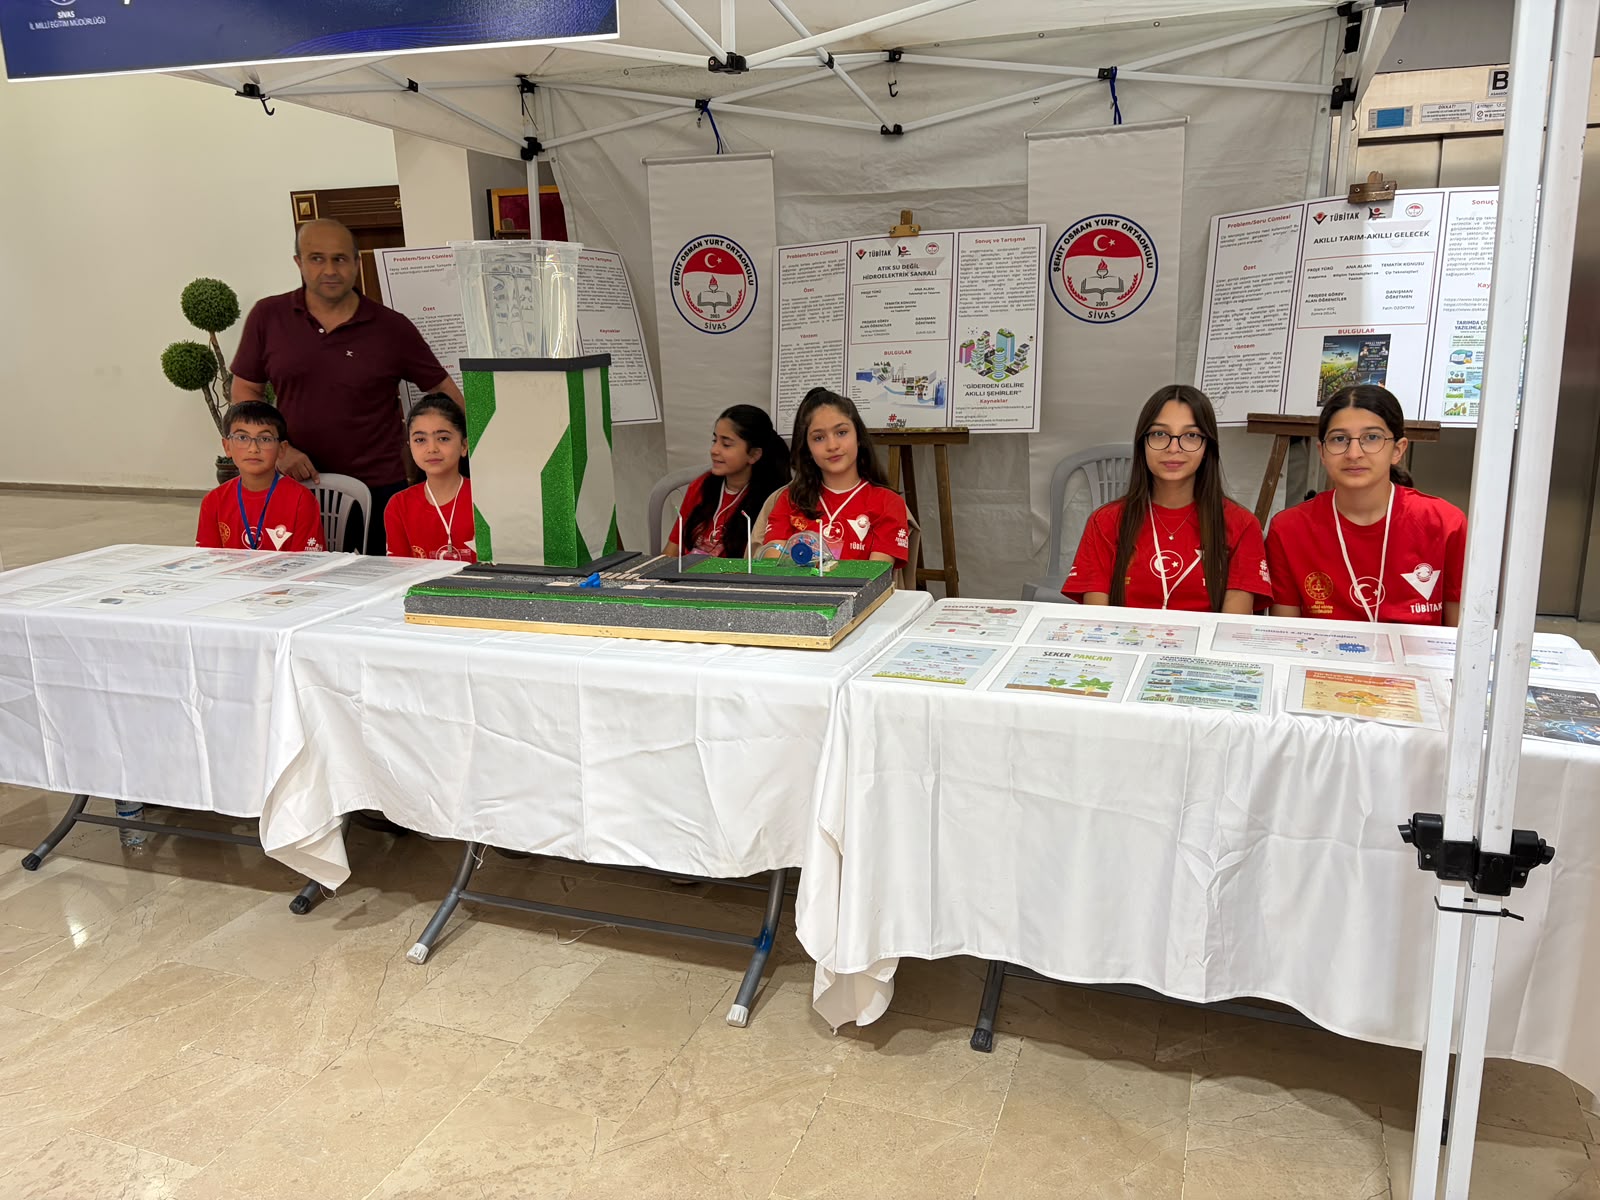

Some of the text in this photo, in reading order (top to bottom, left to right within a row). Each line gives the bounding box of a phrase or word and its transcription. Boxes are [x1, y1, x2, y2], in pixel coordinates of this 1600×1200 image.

[1492, 70, 1509, 90] B
[1330, 212, 1360, 222] TÜBİTAK
[1227, 219, 1267, 229] Problem/Soru
[1313, 237, 1338, 245] AKILLI
[1340, 232, 1393, 242] TARIM-AKILLI
[1053, 219, 1154, 273] ŞEHİT OSMAN YURT ORTAOKULU
[868, 249, 892, 258] TÜBİTAK
[674, 262, 683, 286] ŞEHİT
[680, 240, 703, 262] OSMAN
[704, 239, 725, 247] YURT
[725, 243, 755, 286] ORTAOKULU
[862, 269, 937, 280] HİDROELEKTRİK SANRALİ
[1087, 310, 1117, 320] SİVAS
[704, 322, 727, 330] SİVAS
[1410, 601, 1443, 614] TÜBİTAK
